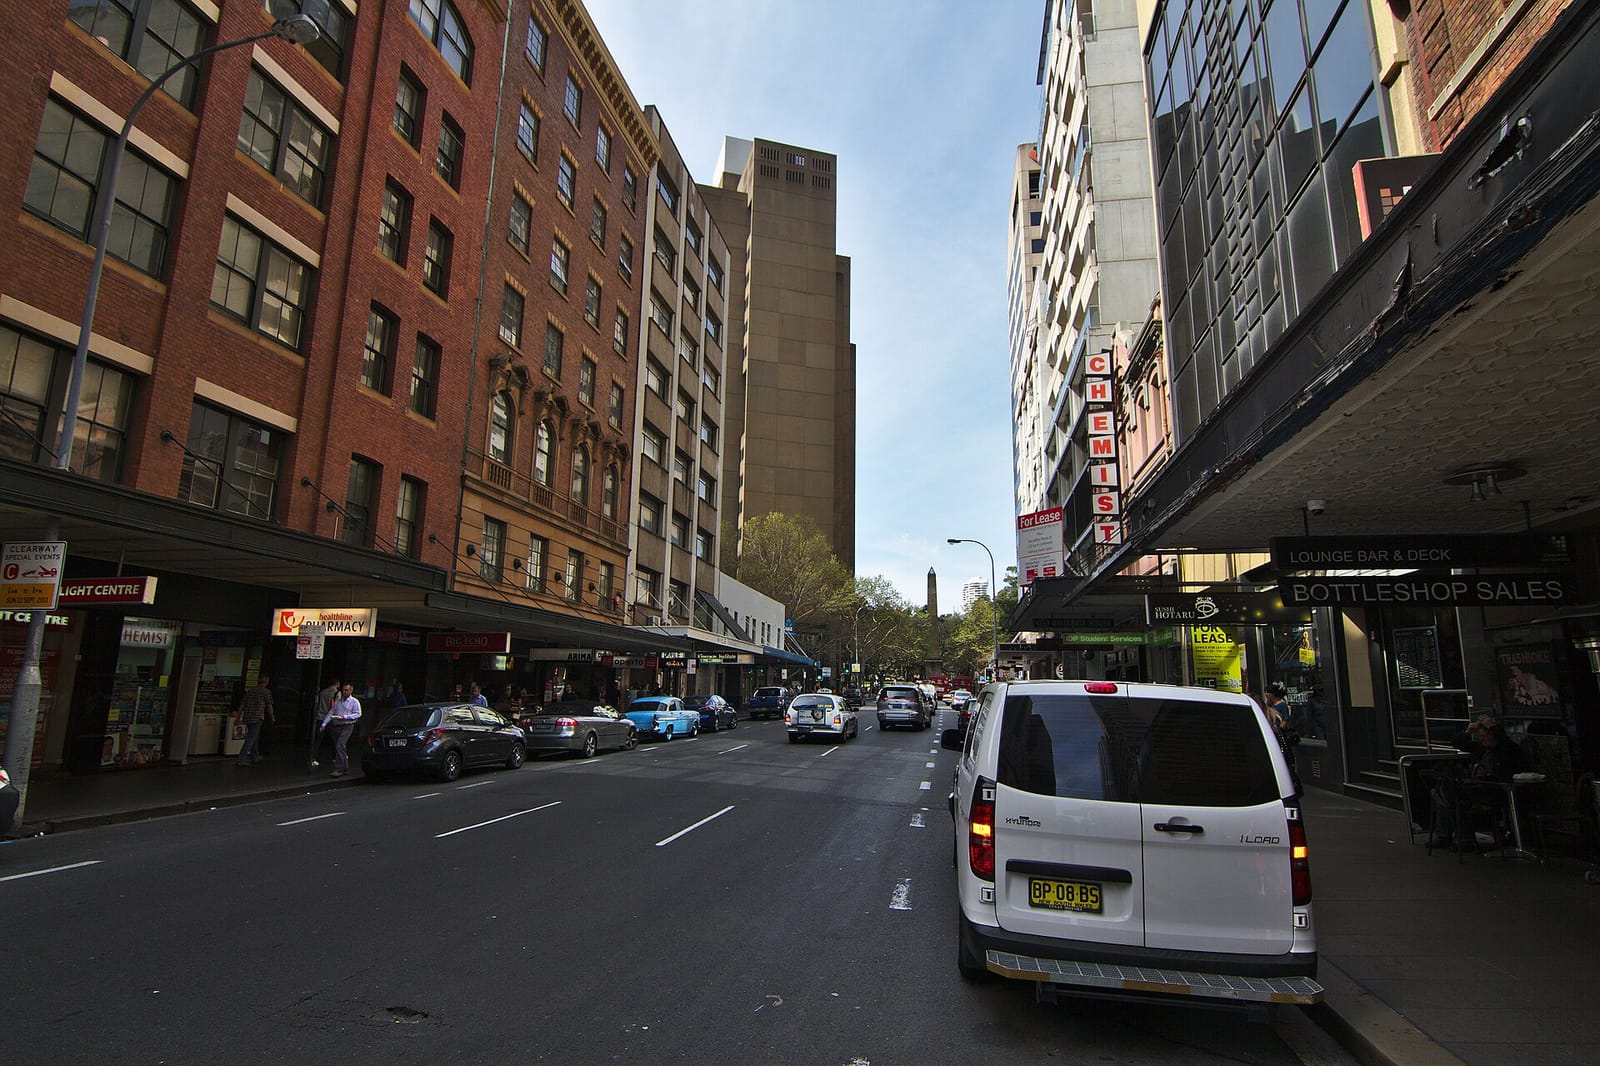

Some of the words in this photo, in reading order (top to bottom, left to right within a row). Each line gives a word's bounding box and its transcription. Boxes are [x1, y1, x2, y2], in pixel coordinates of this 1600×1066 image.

[1089, 356, 1115, 542] CHEMIST
[1020, 516, 1034, 528] For
[1034, 511, 1061, 525] Lease
[10, 545, 58, 553] CLEARWAY
[1290, 551, 1353, 564] LOUNGE
[1357, 550, 1390, 562] BAR
[1393, 549, 1403, 561] &
[1407, 549, 1451, 561] DECK
[59, 585, 93, 597] LIGHT
[94, 584, 140, 596] CENTRE
[1293, 581, 1469, 602] BOTTLESHOP
[1476, 580, 1564, 601] SALES
[14, 611, 69, 626] CETRE
[319, 612, 353, 621] healthline
[1155, 611, 1195, 619] HOTARU
[306, 620, 365, 632] ARMACY
[1193, 624, 1219, 633] FOR
[124, 630, 169, 644] HEMIST
[1110, 635, 1143, 643] Services
[1194, 633, 1233, 643] LEASE
[567, 653, 592, 661] ARIMA
[1005, 817, 1041, 828] HYUNDAI
